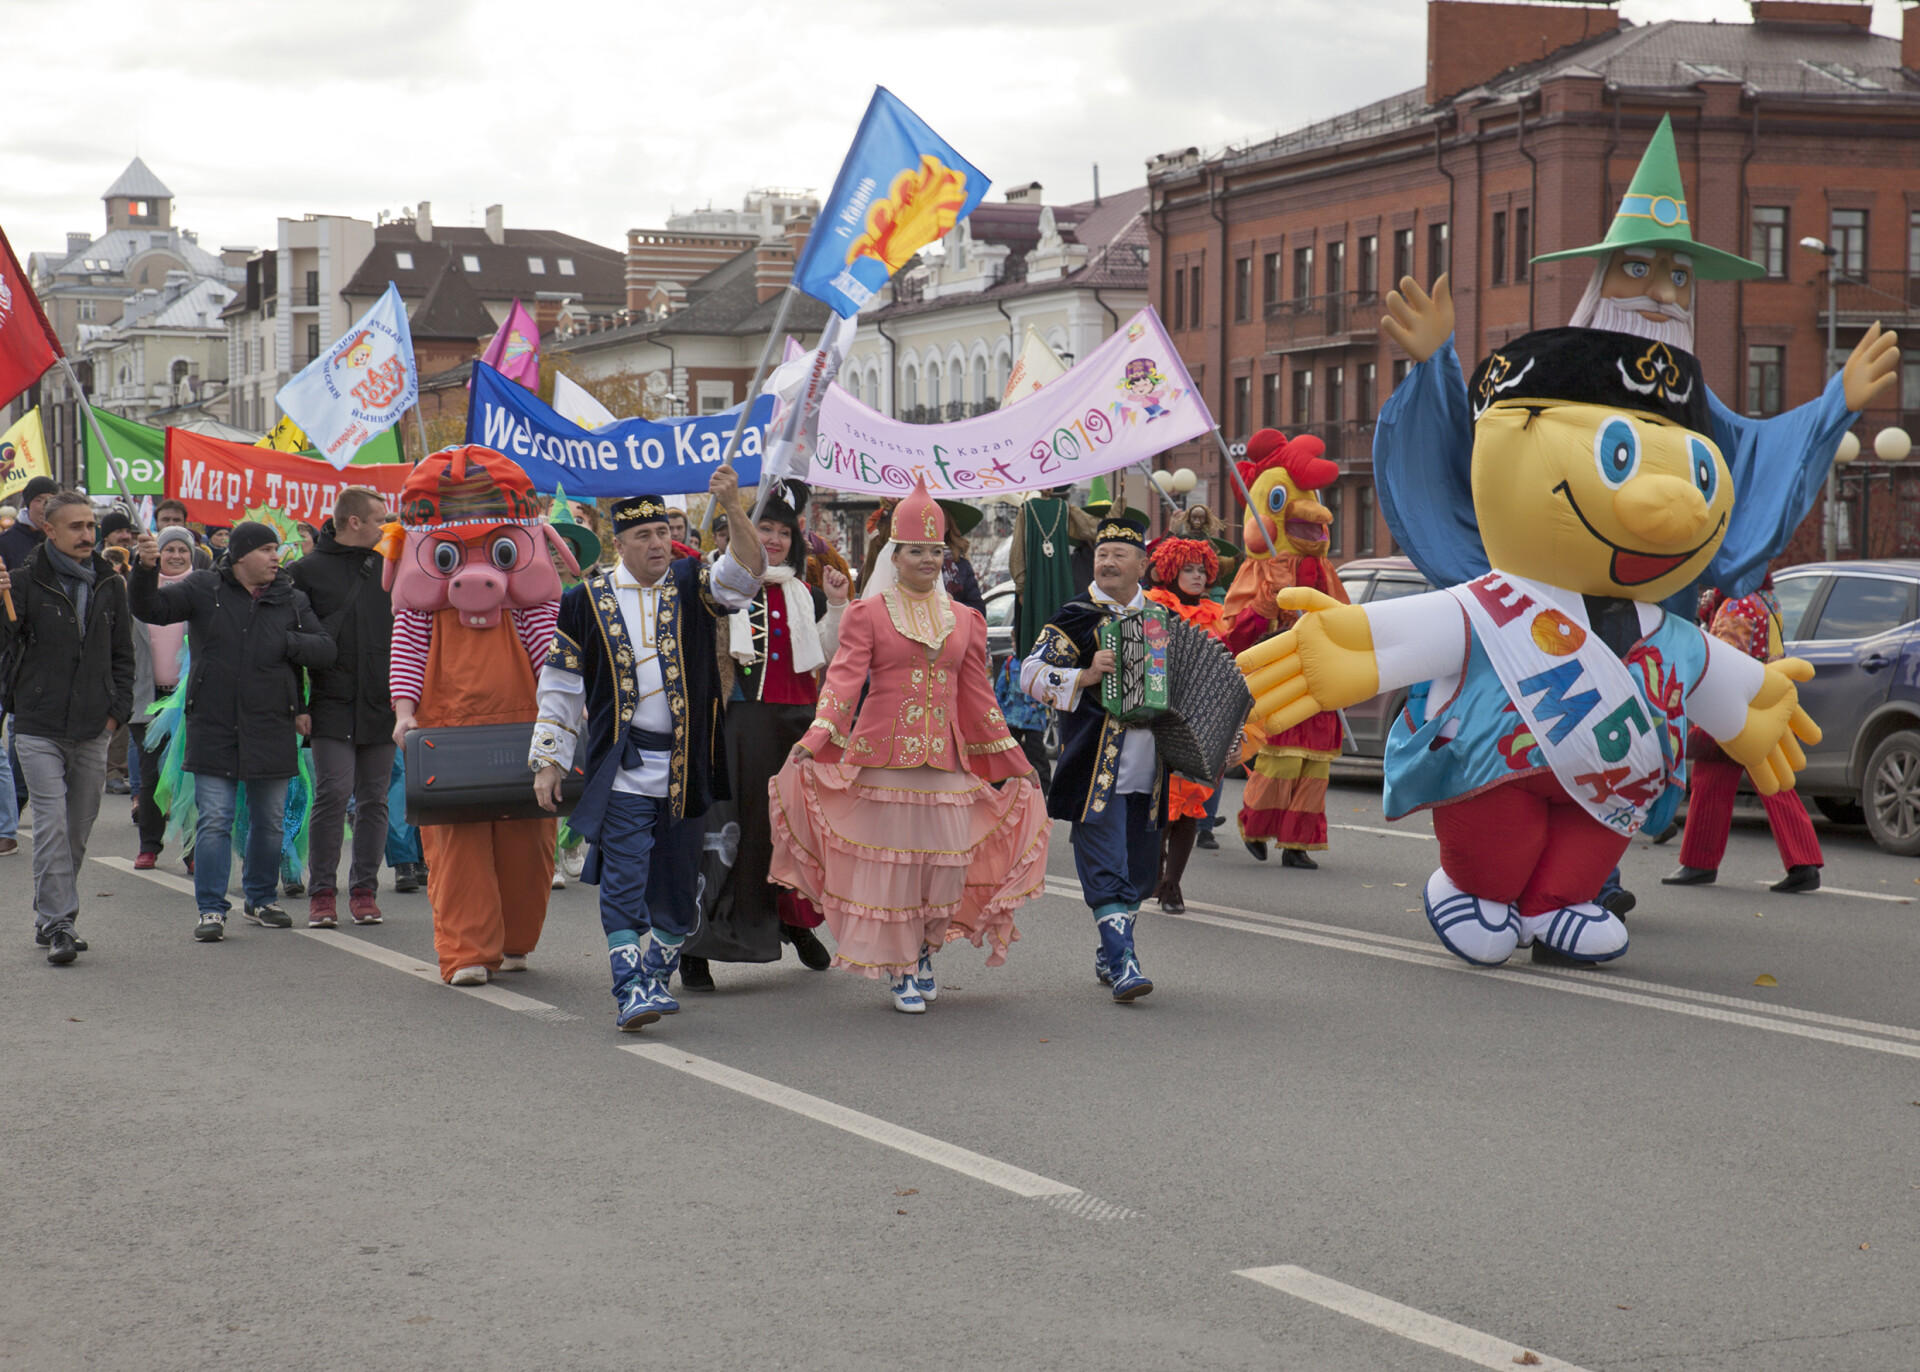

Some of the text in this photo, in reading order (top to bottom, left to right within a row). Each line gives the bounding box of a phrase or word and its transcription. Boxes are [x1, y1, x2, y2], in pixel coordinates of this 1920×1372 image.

[484, 403, 770, 471] Welcome to Kaza
[844, 423, 1014, 456] Tatarstan Kazan
[1030, 408, 1113, 474] 2019
[179, 459, 254, 510] Мир!
[266, 473, 349, 518] Труд
